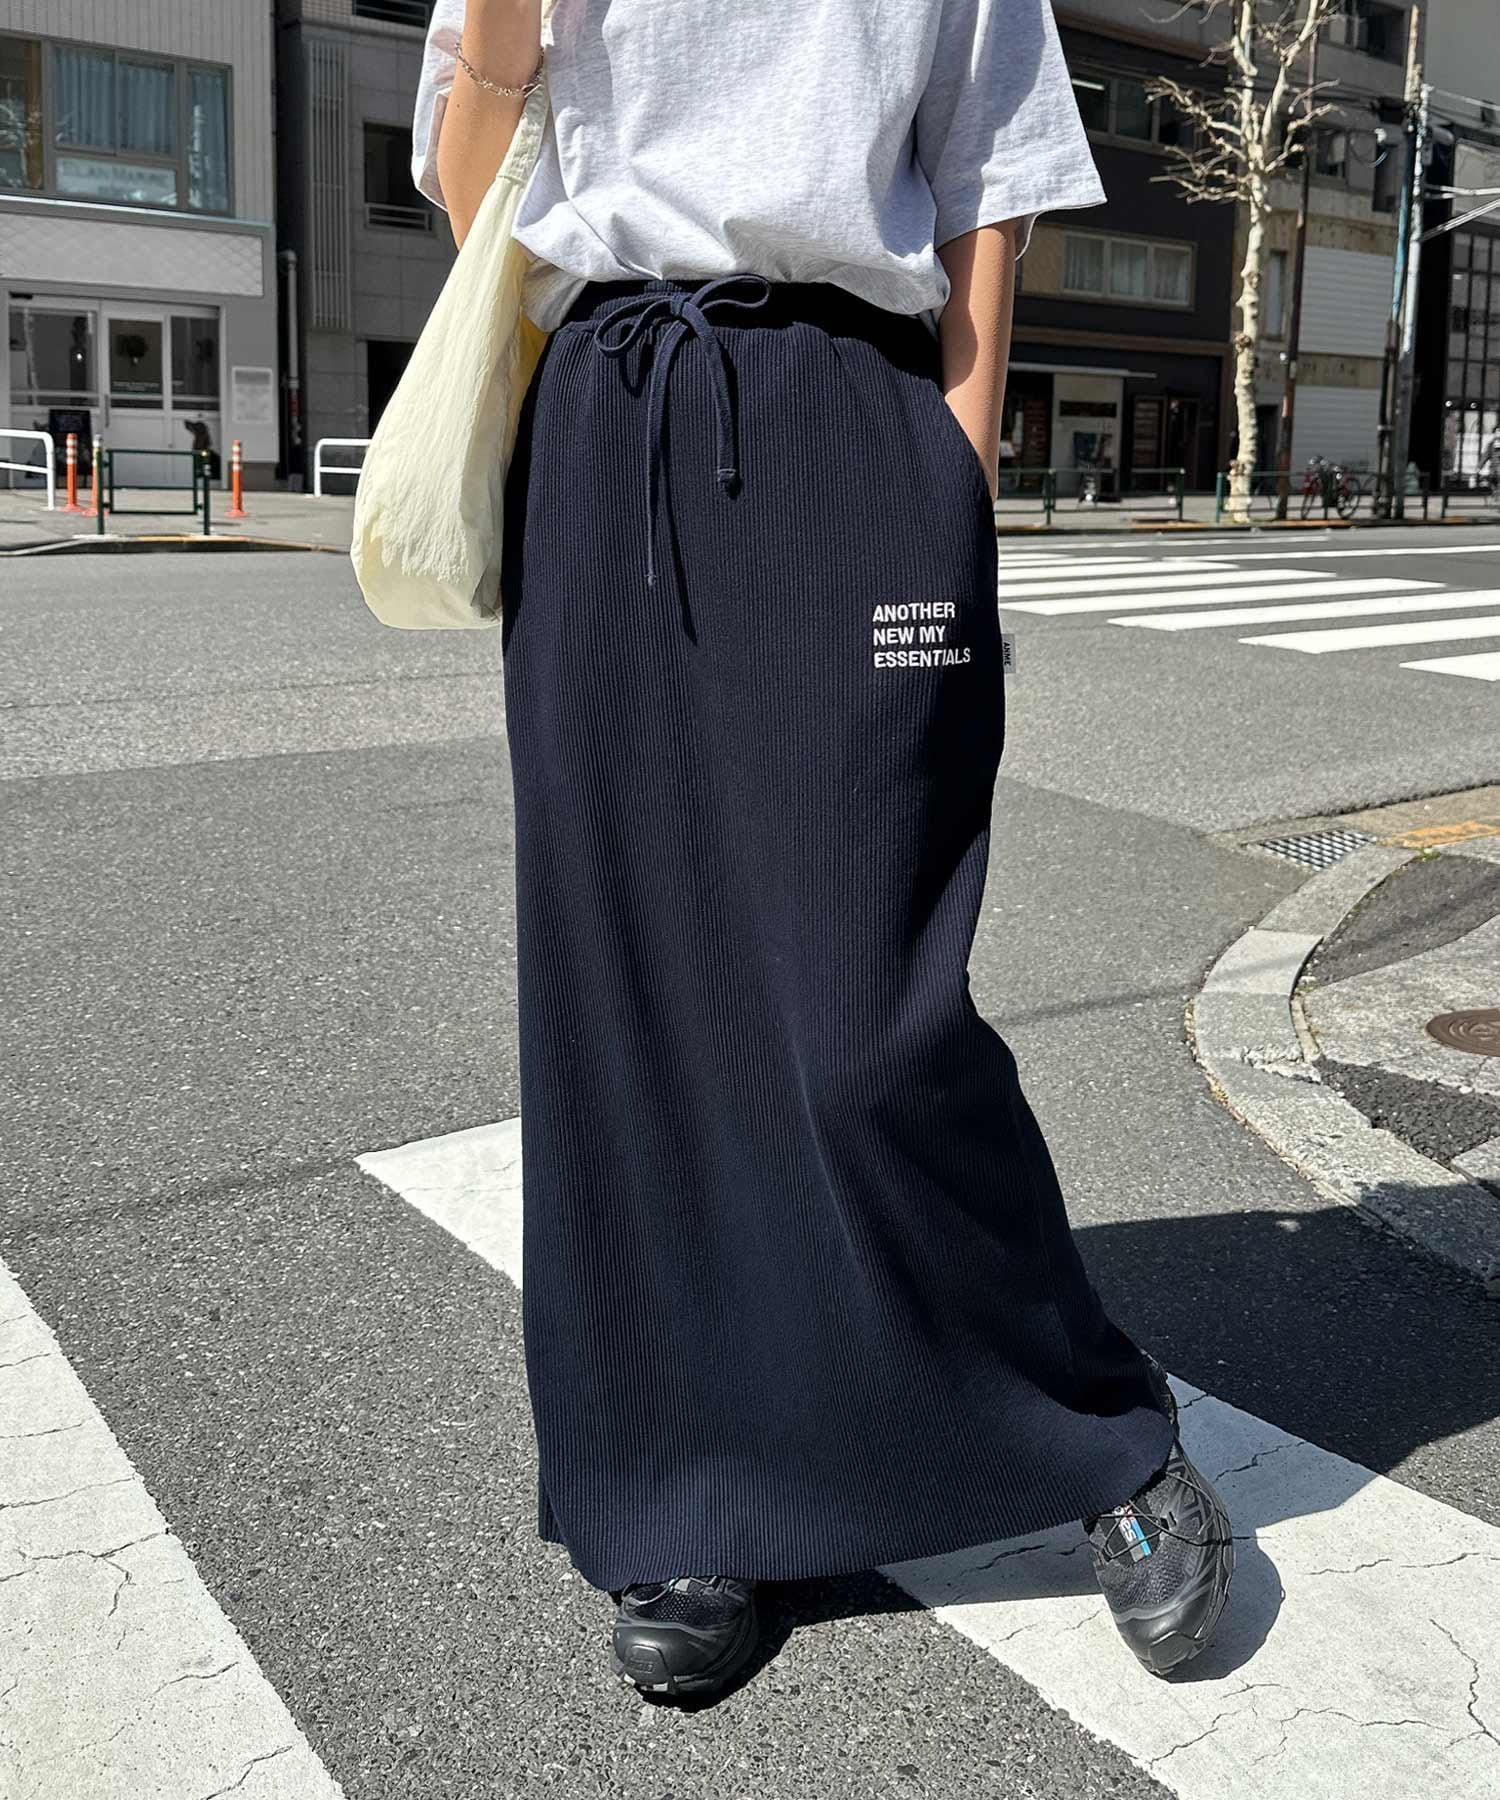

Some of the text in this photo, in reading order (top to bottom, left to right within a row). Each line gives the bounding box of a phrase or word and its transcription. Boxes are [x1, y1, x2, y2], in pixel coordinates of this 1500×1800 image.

[872, 602, 956, 623] ANOTHER
[873, 625, 946, 646] NEW MY
[874, 647, 971, 668] ESSENTIALS
